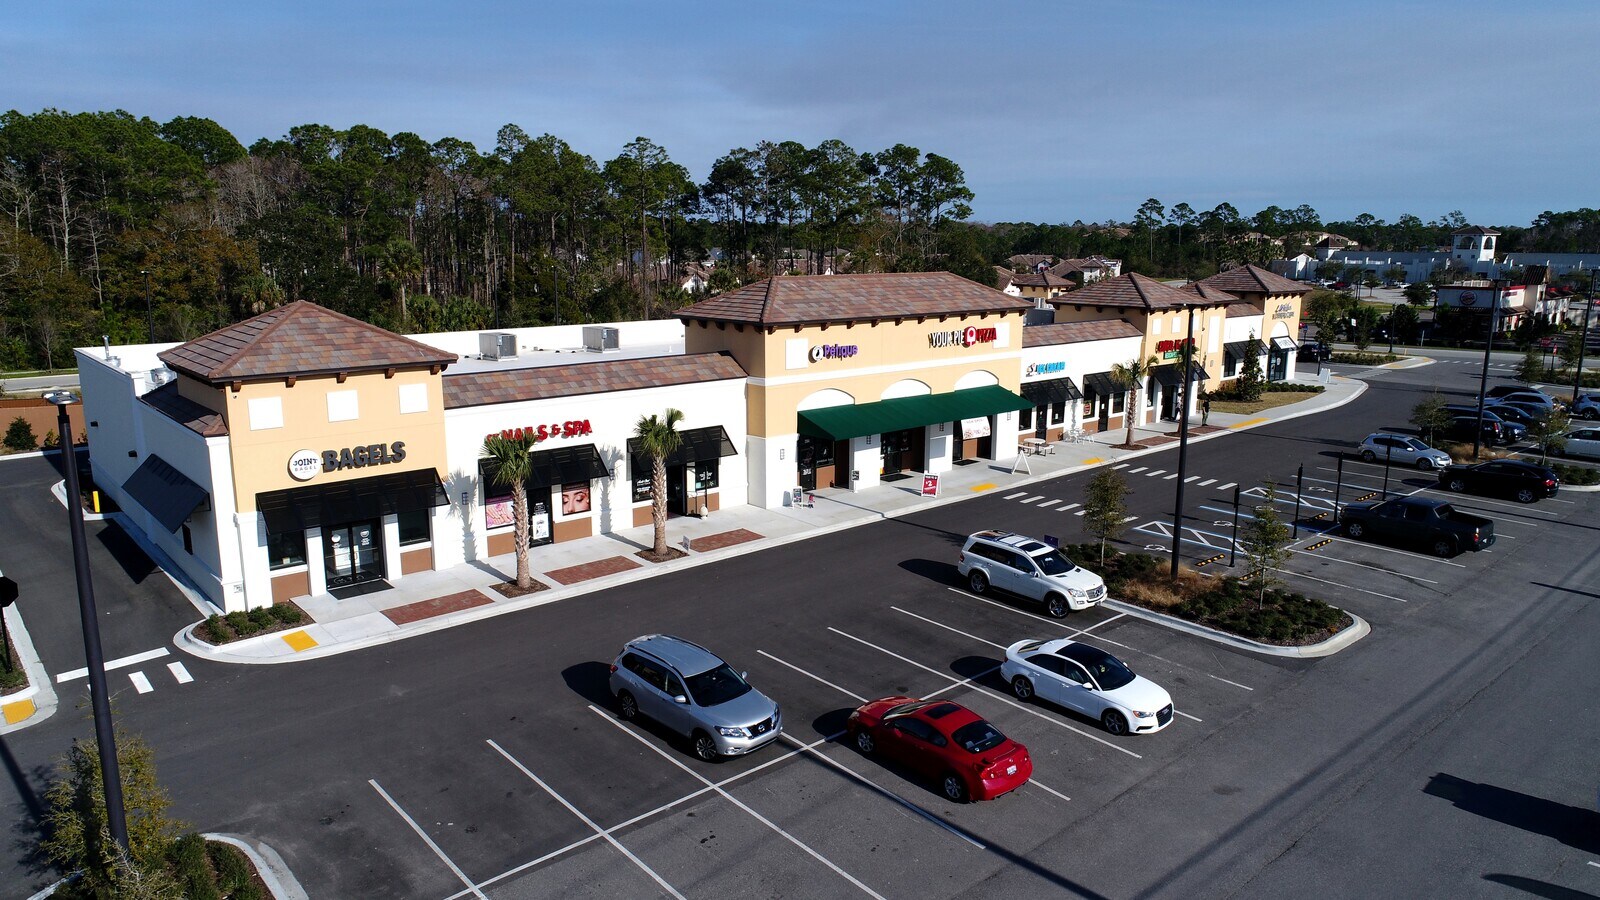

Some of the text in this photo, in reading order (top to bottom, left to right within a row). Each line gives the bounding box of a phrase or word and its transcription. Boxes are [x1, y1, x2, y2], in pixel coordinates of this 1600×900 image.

[551, 424, 561, 436] &
[563, 419, 593, 438] SPA
[293, 458, 318, 467] JOINT
[322, 441, 407, 473] BAGELS
